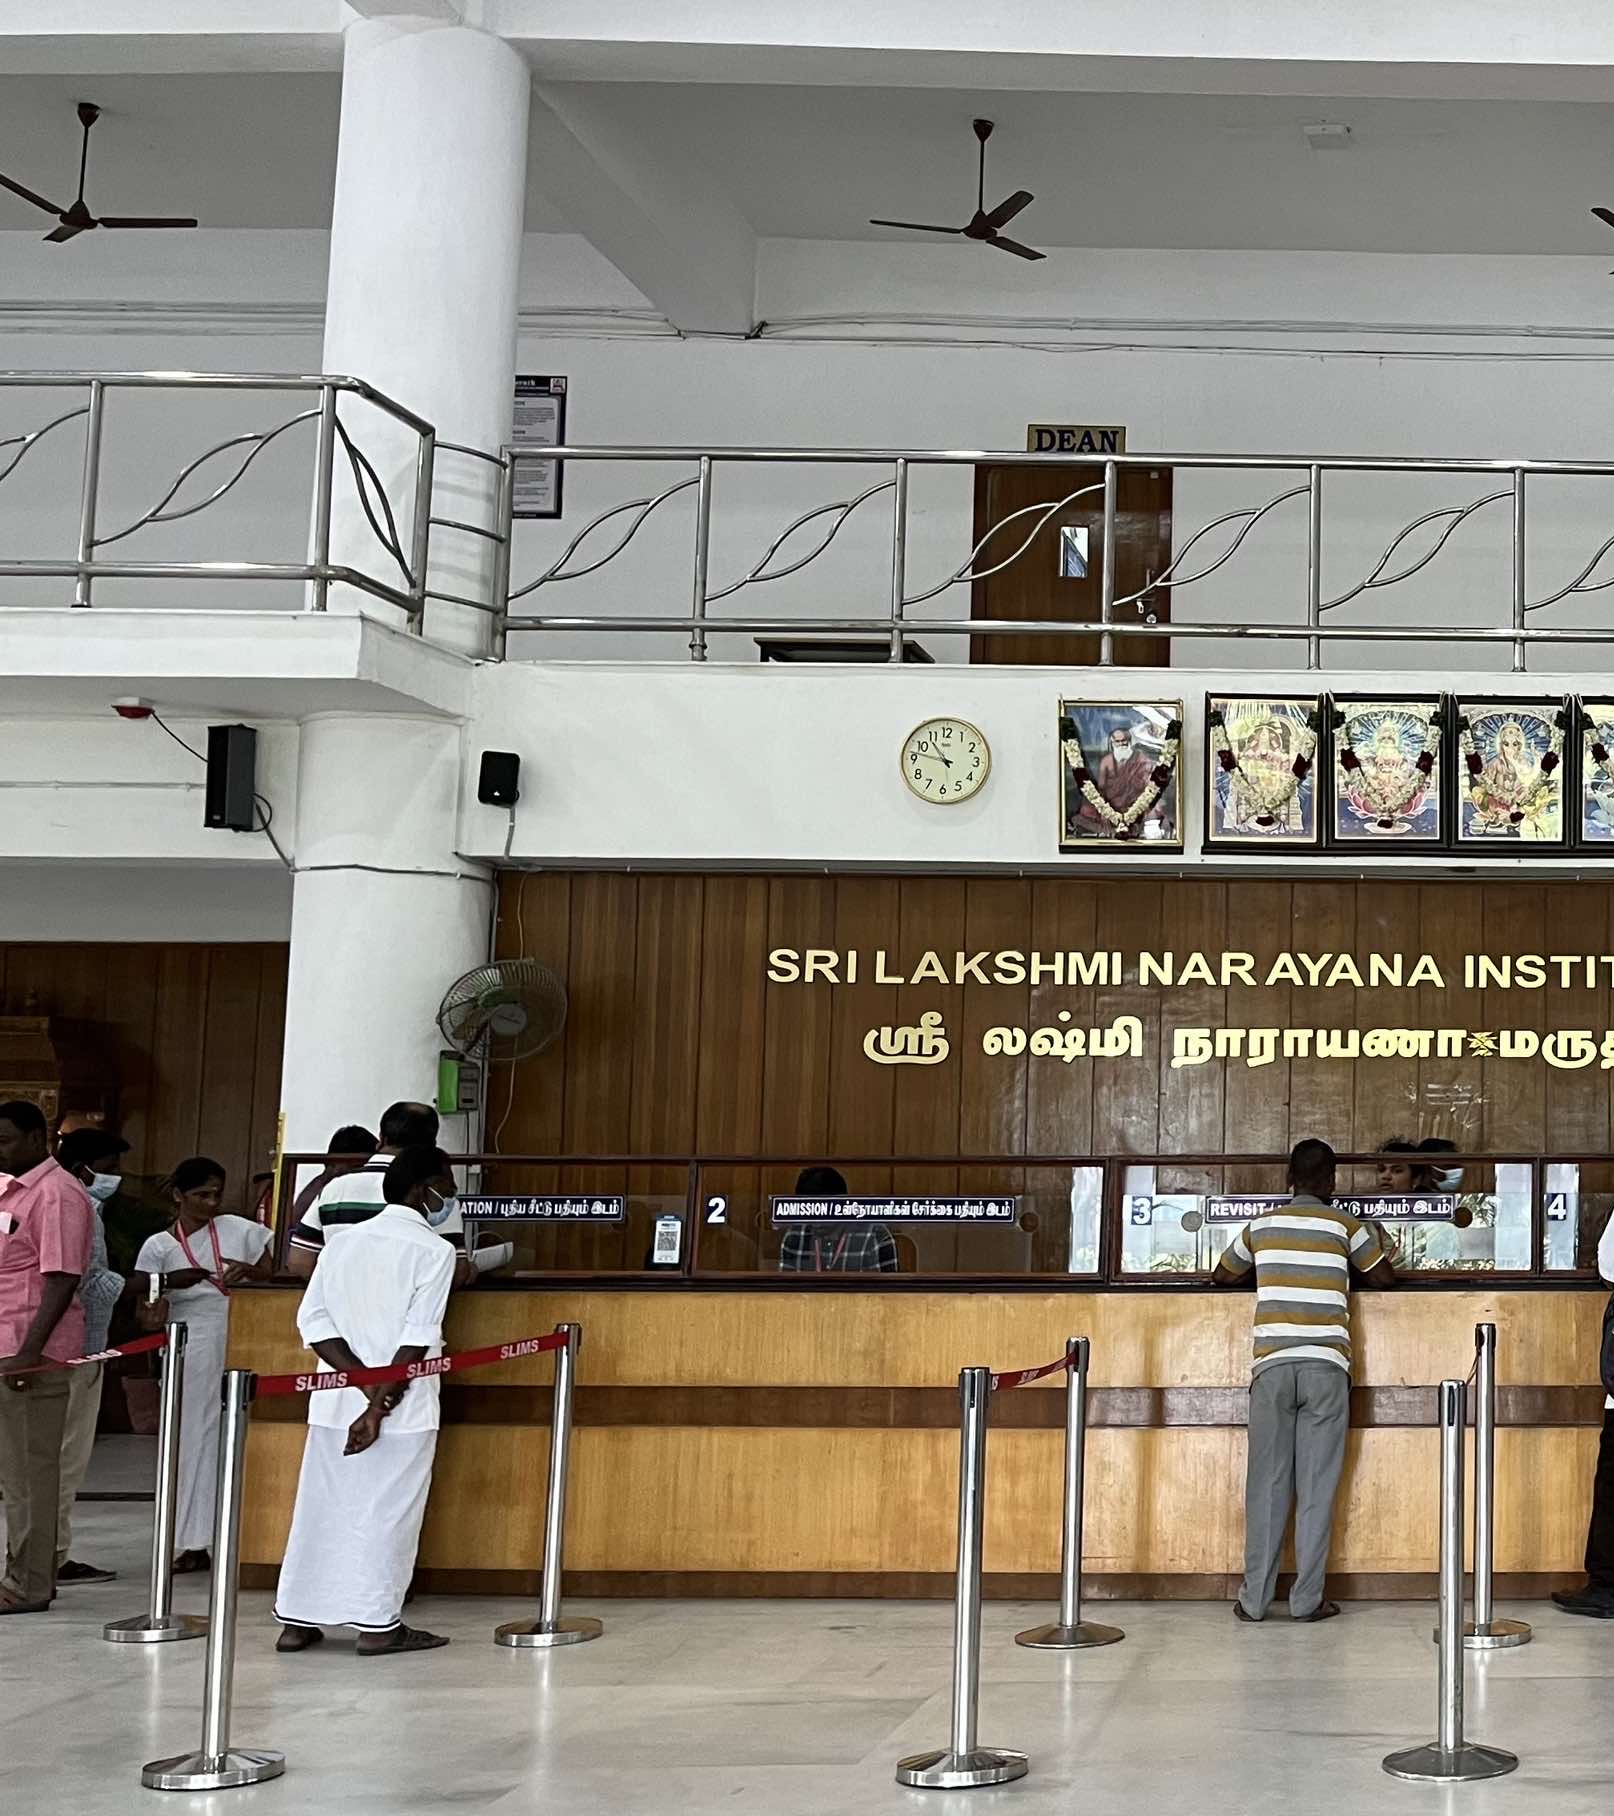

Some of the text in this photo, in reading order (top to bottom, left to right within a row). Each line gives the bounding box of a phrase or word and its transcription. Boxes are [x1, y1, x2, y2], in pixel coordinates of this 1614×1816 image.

[1035, 429, 1119, 452] DEAN
[929, 731, 938, 742] 11
[942, 727, 952, 738] 12
[960, 731, 964, 743] 1
[917, 740, 928, 752] 10
[968, 742, 976, 753] 2
[910, 753, 918, 765] 9
[972, 756, 980, 767] 3
[914, 768, 922, 780] 8
[966, 771, 973, 782] 4
[926, 779, 932, 790] 7
[939, 783, 947, 795] 6
[954, 780, 962, 792] 5
[767, 948, 856, 984] SRI
[874, 950, 1123, 986] LAKSHMI
[982, 1010, 1144, 1064] லஷ்மி
[1172, 1028, 1467, 1067] நாராயணா
[460, 1201, 493, 1214] ATION
[591, 1199, 619, 1215] இடம்
[708, 1197, 726, 1223] 2
[776, 1202, 828, 1216] ADMISSION
[986, 1201, 1011, 1216] இடம்
[1133, 1198, 1151, 1224] 3
[1211, 1202, 1266, 1217] REVISIT
[1364, 1199, 1410, 1217] பதியும்
[1412, 1199, 1450, 1215] இடம்
[1547, 1194, 1567, 1220] 4
[500, 1338, 540, 1360] SLIMS
[406, 1356, 451, 1379] SLIMS
[295, 1371, 348, 1392] SLIMS
